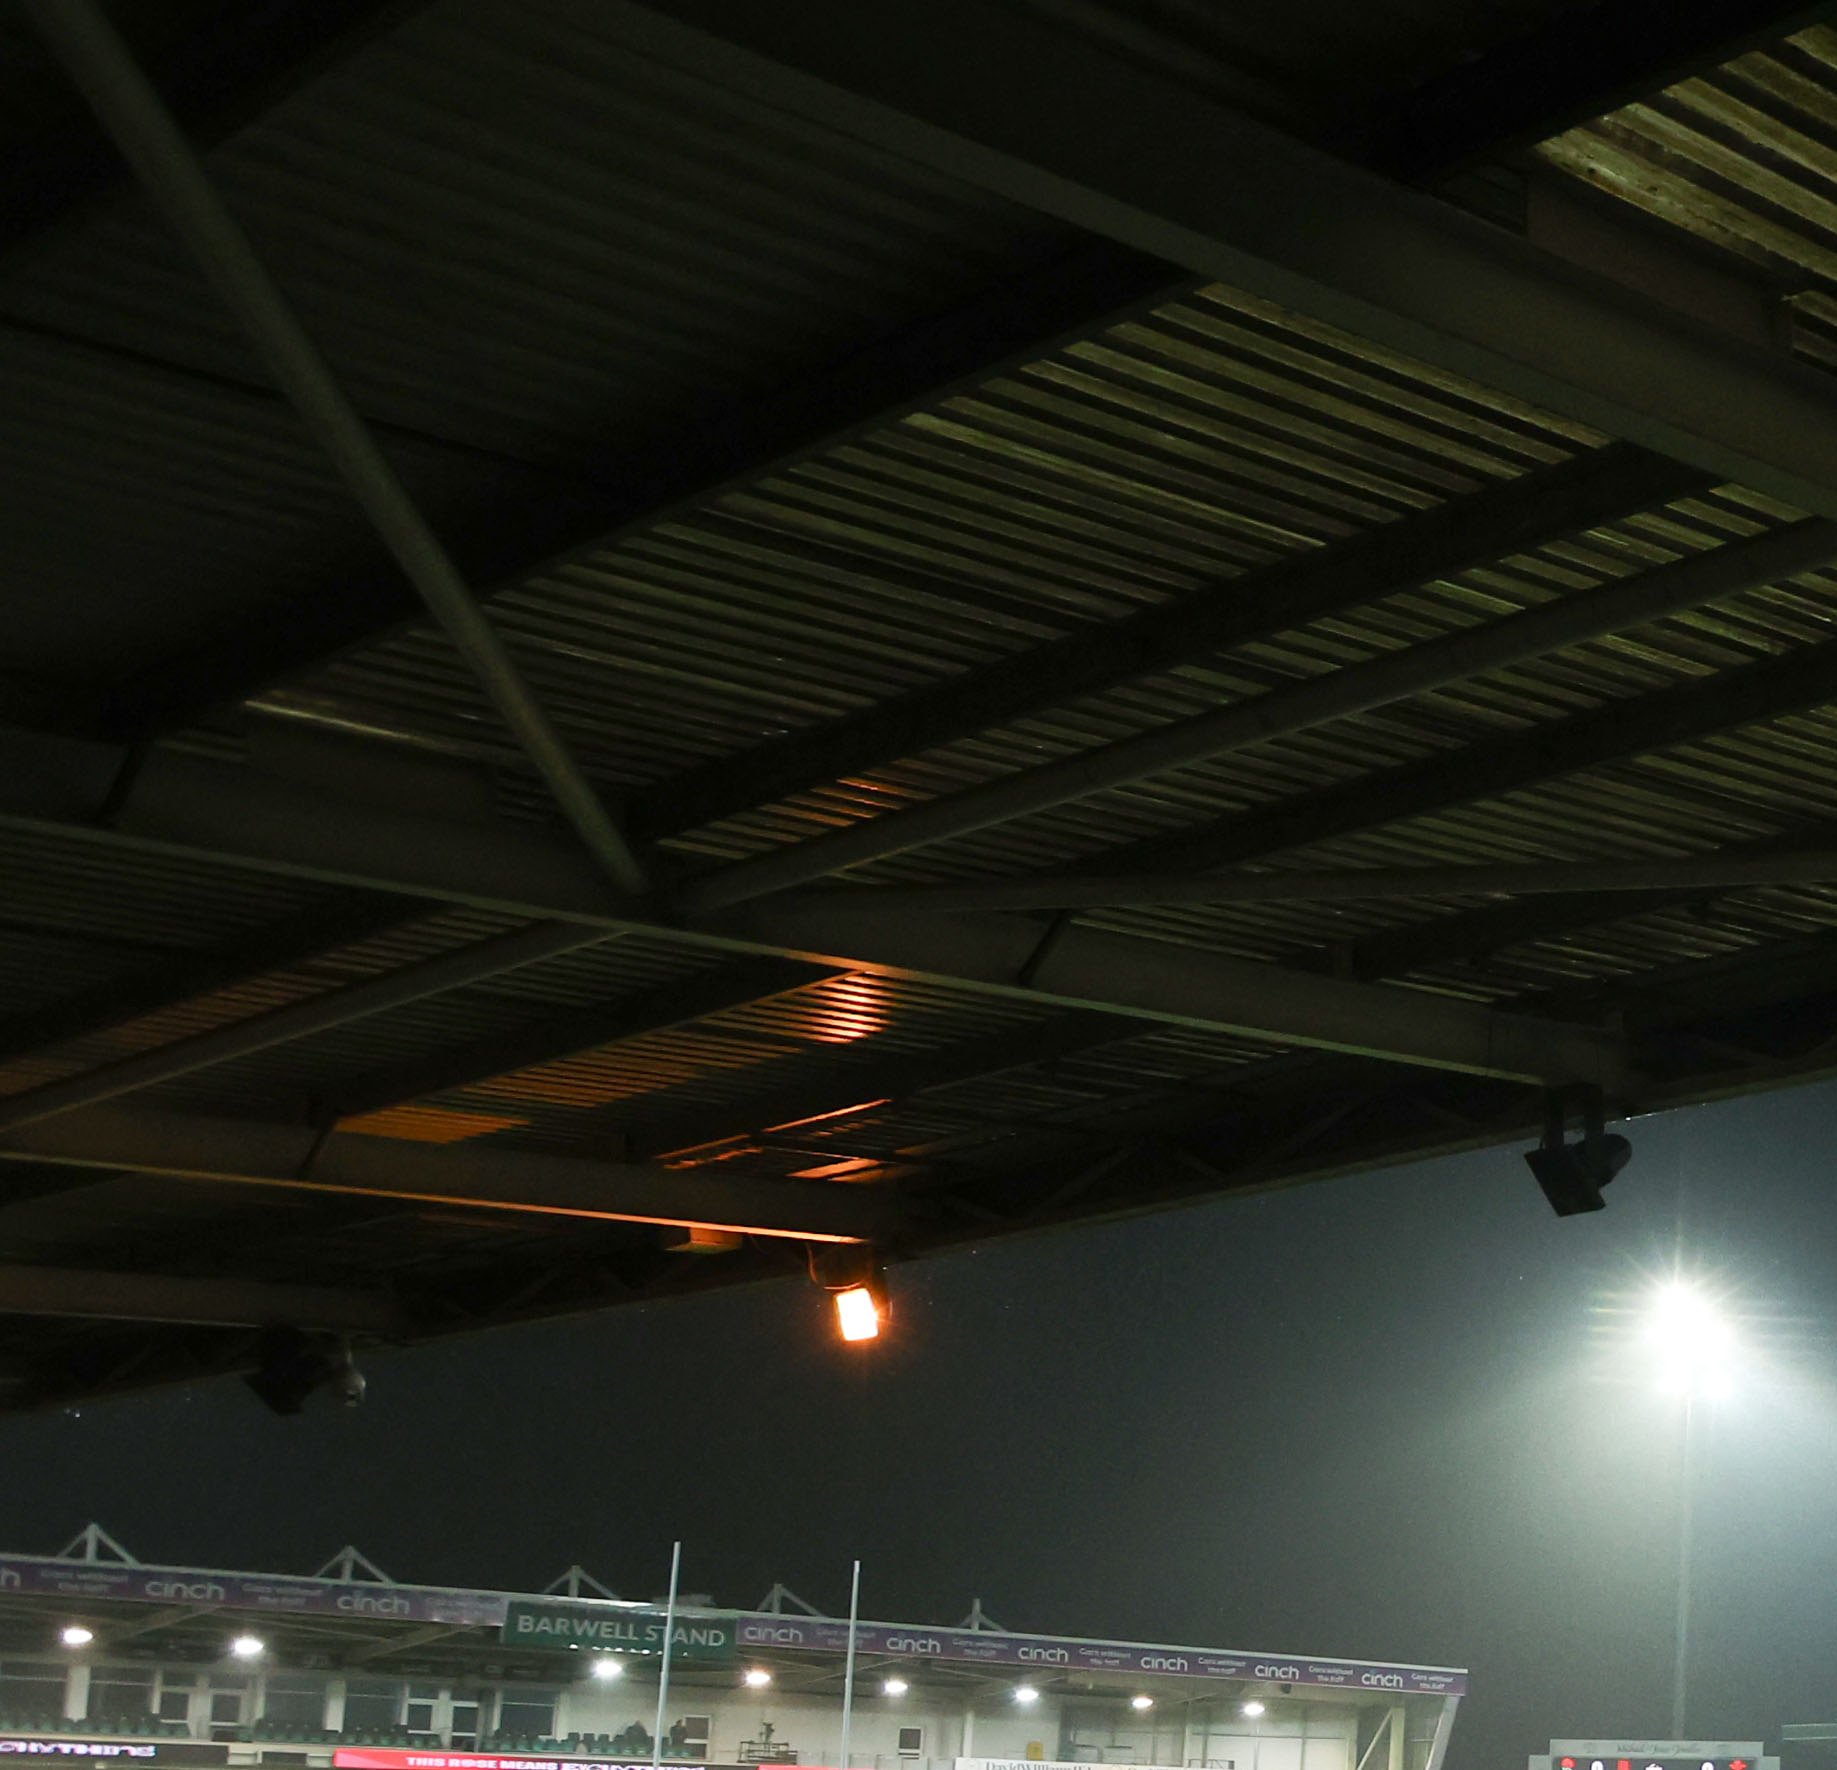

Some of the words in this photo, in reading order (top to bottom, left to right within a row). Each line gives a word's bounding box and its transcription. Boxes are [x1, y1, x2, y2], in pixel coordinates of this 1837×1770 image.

[145, 1579, 226, 1601] cinch
[337, 1590, 410, 1616] cinch
[517, 1614, 640, 1641] BARWELL
[645, 1624, 725, 1648] STAND
[744, 1624, 803, 1643] cinch
[886, 1635, 942, 1654] cinch
[1018, 1645, 1069, 1664] cinch
[1140, 1655, 1189, 1673] cinch
[1254, 1663, 1300, 1681] cinch
[1361, 1671, 1404, 1689] cinch
[406, 1756, 446, 1768] THIS
[448, 1757, 497, 1769] ROSE
